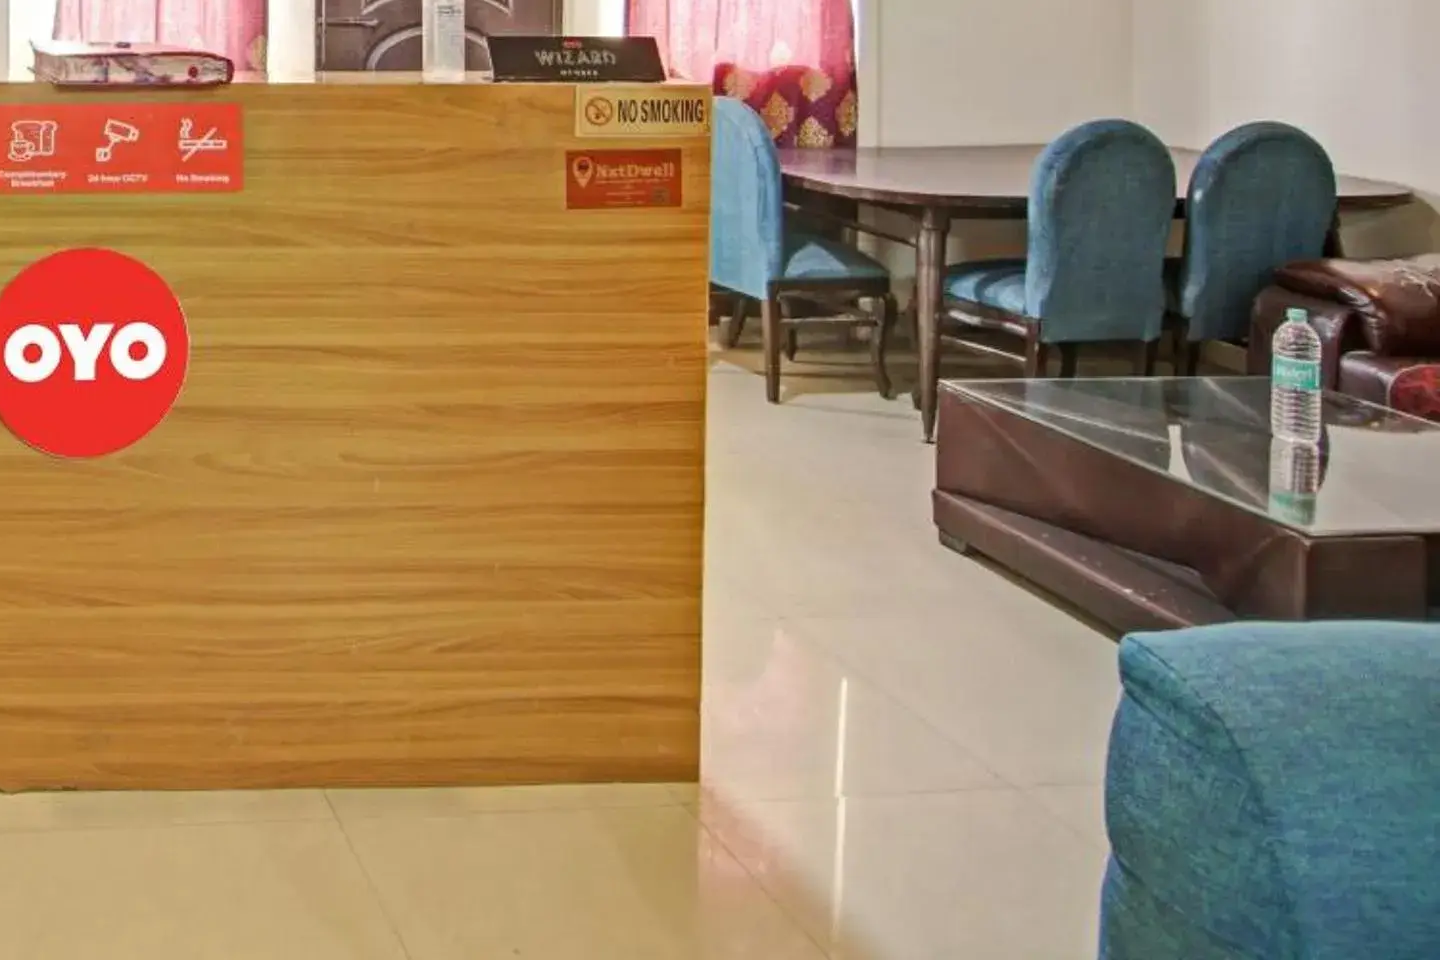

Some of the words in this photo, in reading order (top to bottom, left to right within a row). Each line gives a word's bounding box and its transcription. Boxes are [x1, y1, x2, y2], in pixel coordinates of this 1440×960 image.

[617, 99, 638, 123] NO
[640, 99, 704, 123] SMOKING
[3, 321, 168, 383] OYO
